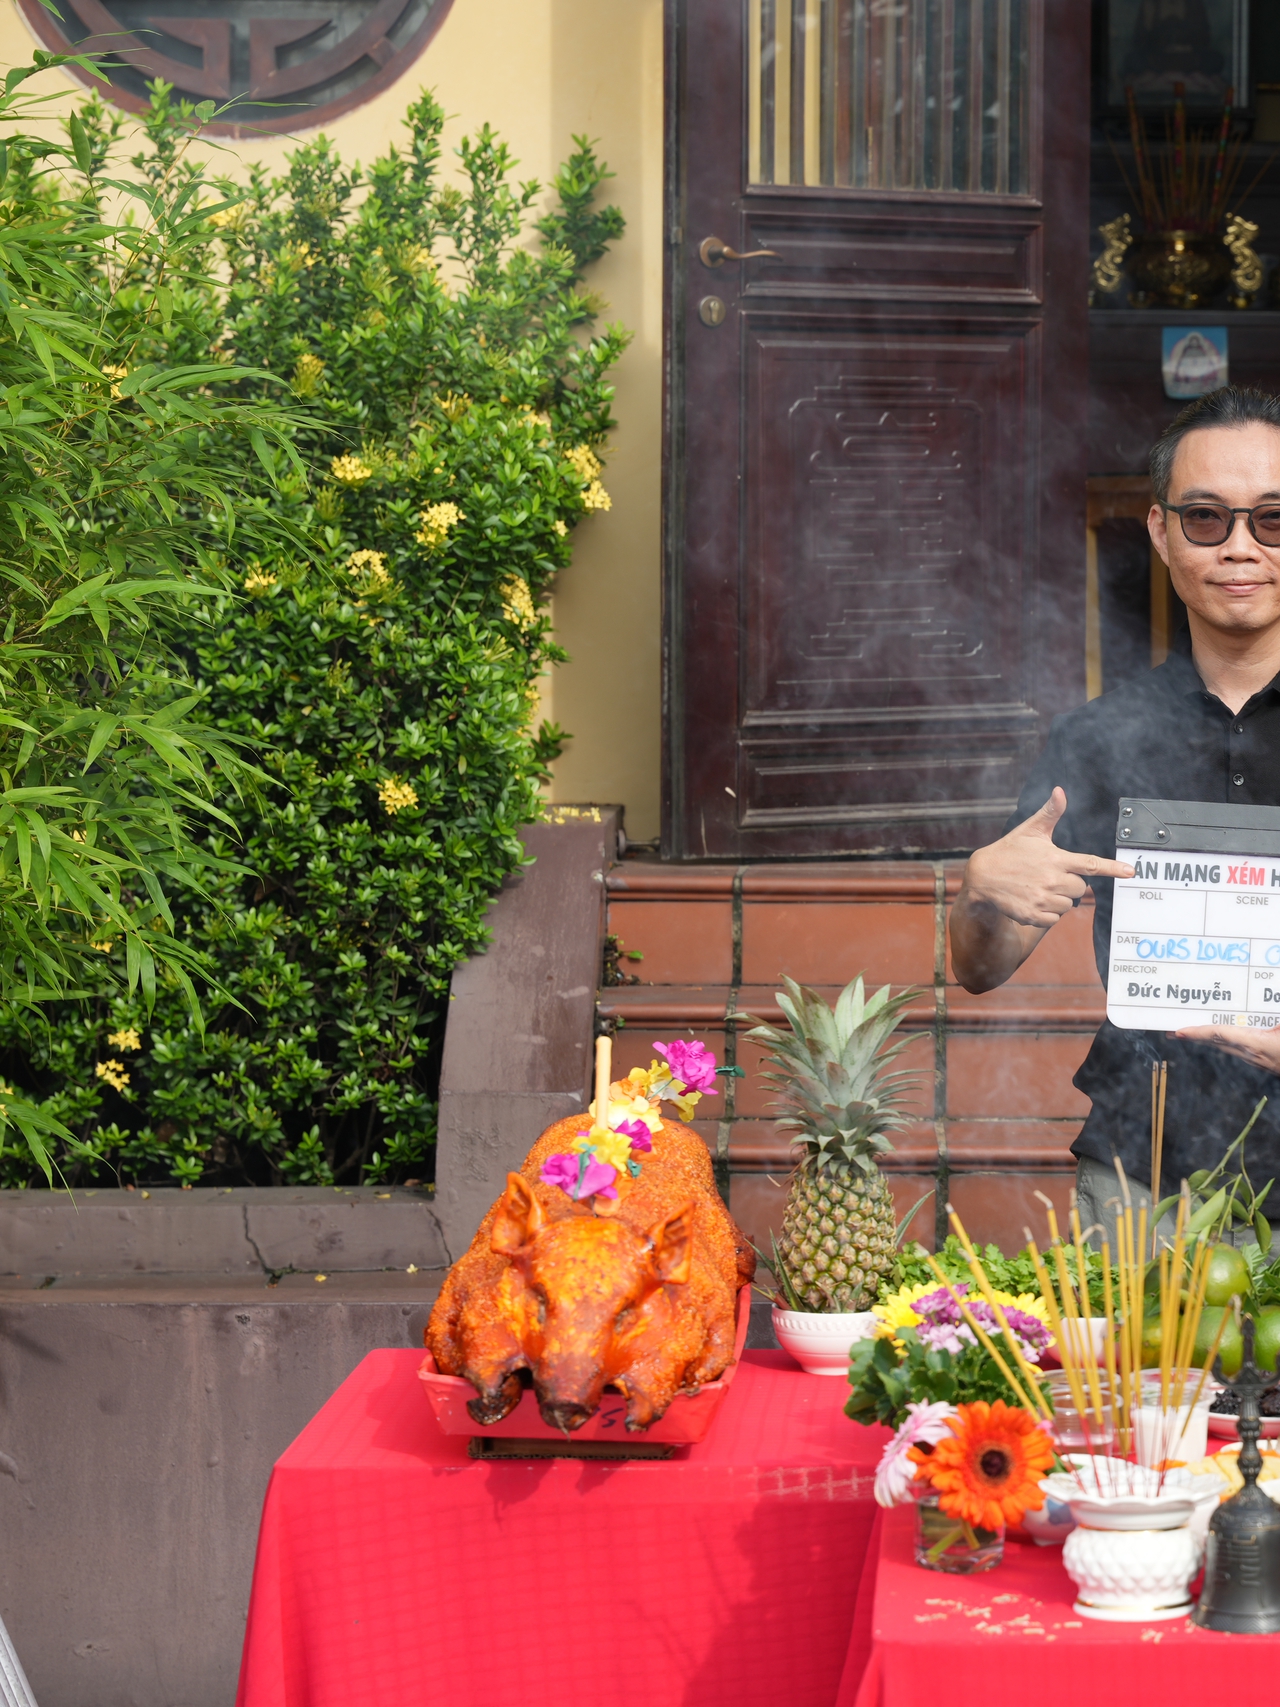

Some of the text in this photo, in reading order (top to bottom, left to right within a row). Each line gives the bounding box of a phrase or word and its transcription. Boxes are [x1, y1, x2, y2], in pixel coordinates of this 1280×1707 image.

[1133, 855, 1158, 880] ÁN
[1164, 862, 1220, 887] MẠNG
[1226, 861, 1265, 886] XÉM
[1139, 891, 1163, 901] ROLL
[1236, 895, 1269, 906] SCENE
[1117, 936, 1140, 945] DATE
[1136, 938, 1190, 960] OURS
[1196, 939, 1250, 963] LOVES
[1113, 964, 1157, 974] DIRECTOR
[1254, 971, 1274, 980] DOP
[1127, 982, 1232, 1005] Đức Nguyễn
[1212, 1014, 1235, 1025] CINE
